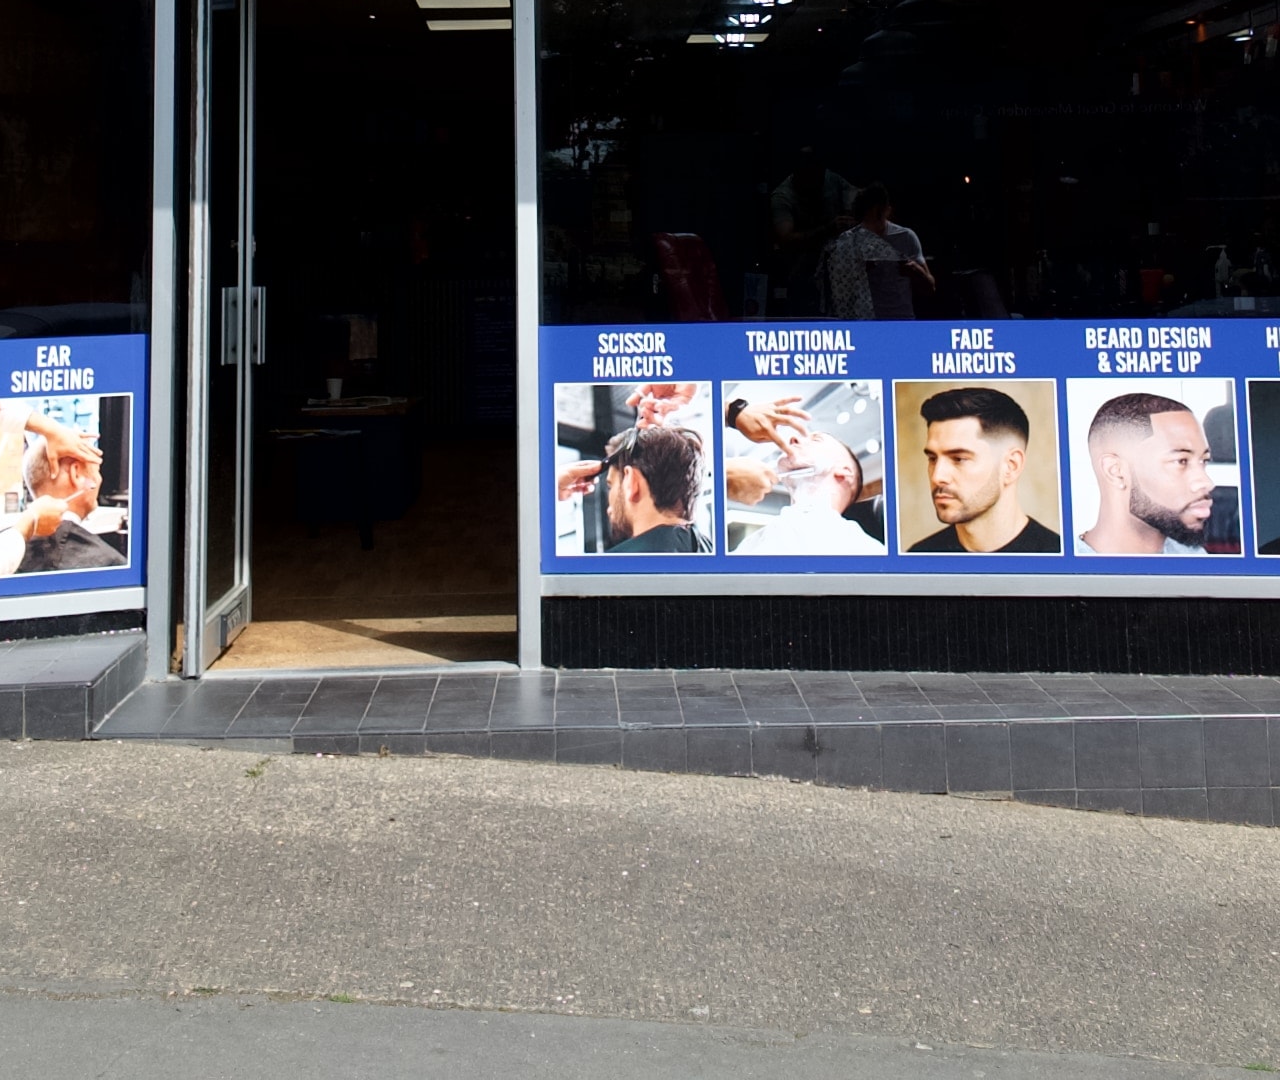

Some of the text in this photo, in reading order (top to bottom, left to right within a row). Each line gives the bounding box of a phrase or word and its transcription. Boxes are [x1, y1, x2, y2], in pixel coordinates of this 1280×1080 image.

[597, 332, 667, 355] SCISSOR
[746, 329, 856, 353] TRADITIONAL
[950, 328, 995, 351] FADE
[1085, 326, 1212, 349] BEARD DESIGN
[36, 344, 72, 369] EAR
[592, 354, 674, 379] HAIRCUTS
[754, 353, 849, 377] WET SHAVE
[931, 351, 1017, 376] HAIRCUTS
[1097, 350, 1202, 373] & SHAPE UP
[10, 366, 95, 394] SINGEING
